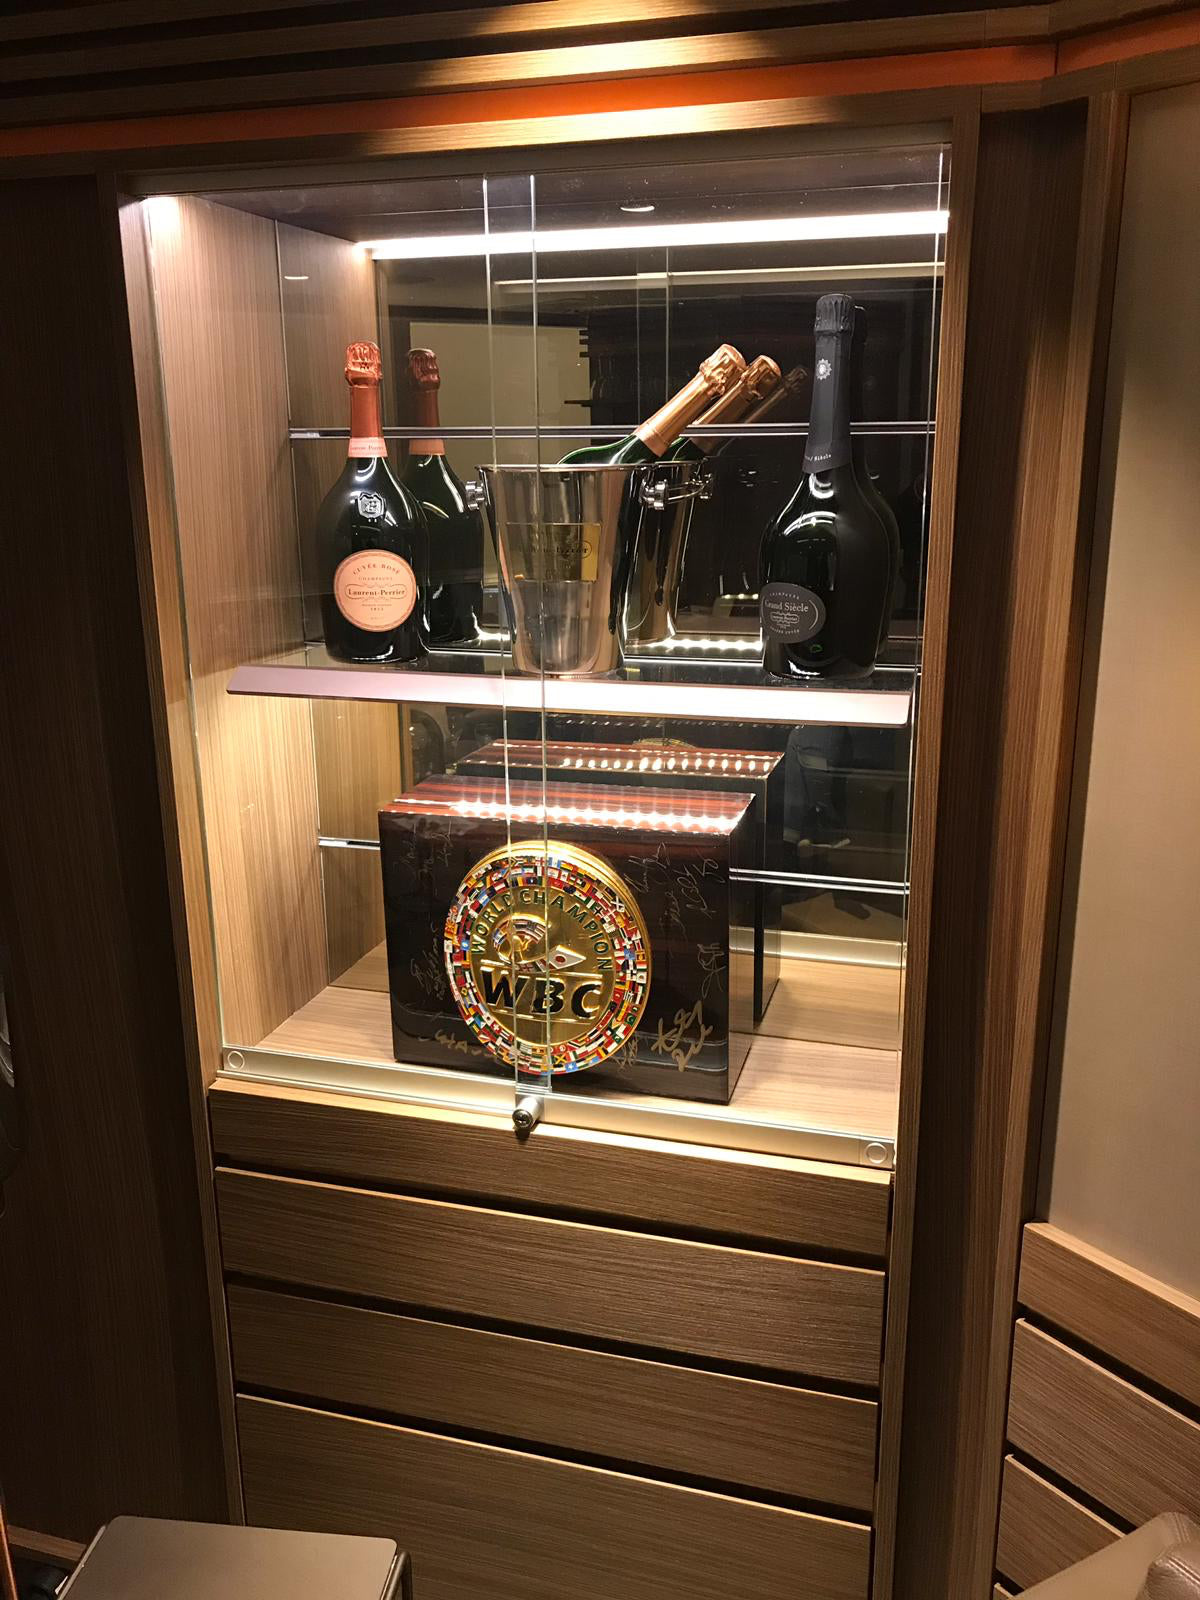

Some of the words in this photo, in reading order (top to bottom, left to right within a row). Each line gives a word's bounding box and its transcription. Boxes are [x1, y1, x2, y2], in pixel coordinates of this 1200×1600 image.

[348, 588, 405, 596] Laurent-Perrier
[764, 599, 783, 610] Grand
[784, 601, 809, 613] Siècle
[471, 893, 513, 955] WORLD
[519, 888, 613, 971] CHAMPION
[479, 967, 602, 1018] WBC
